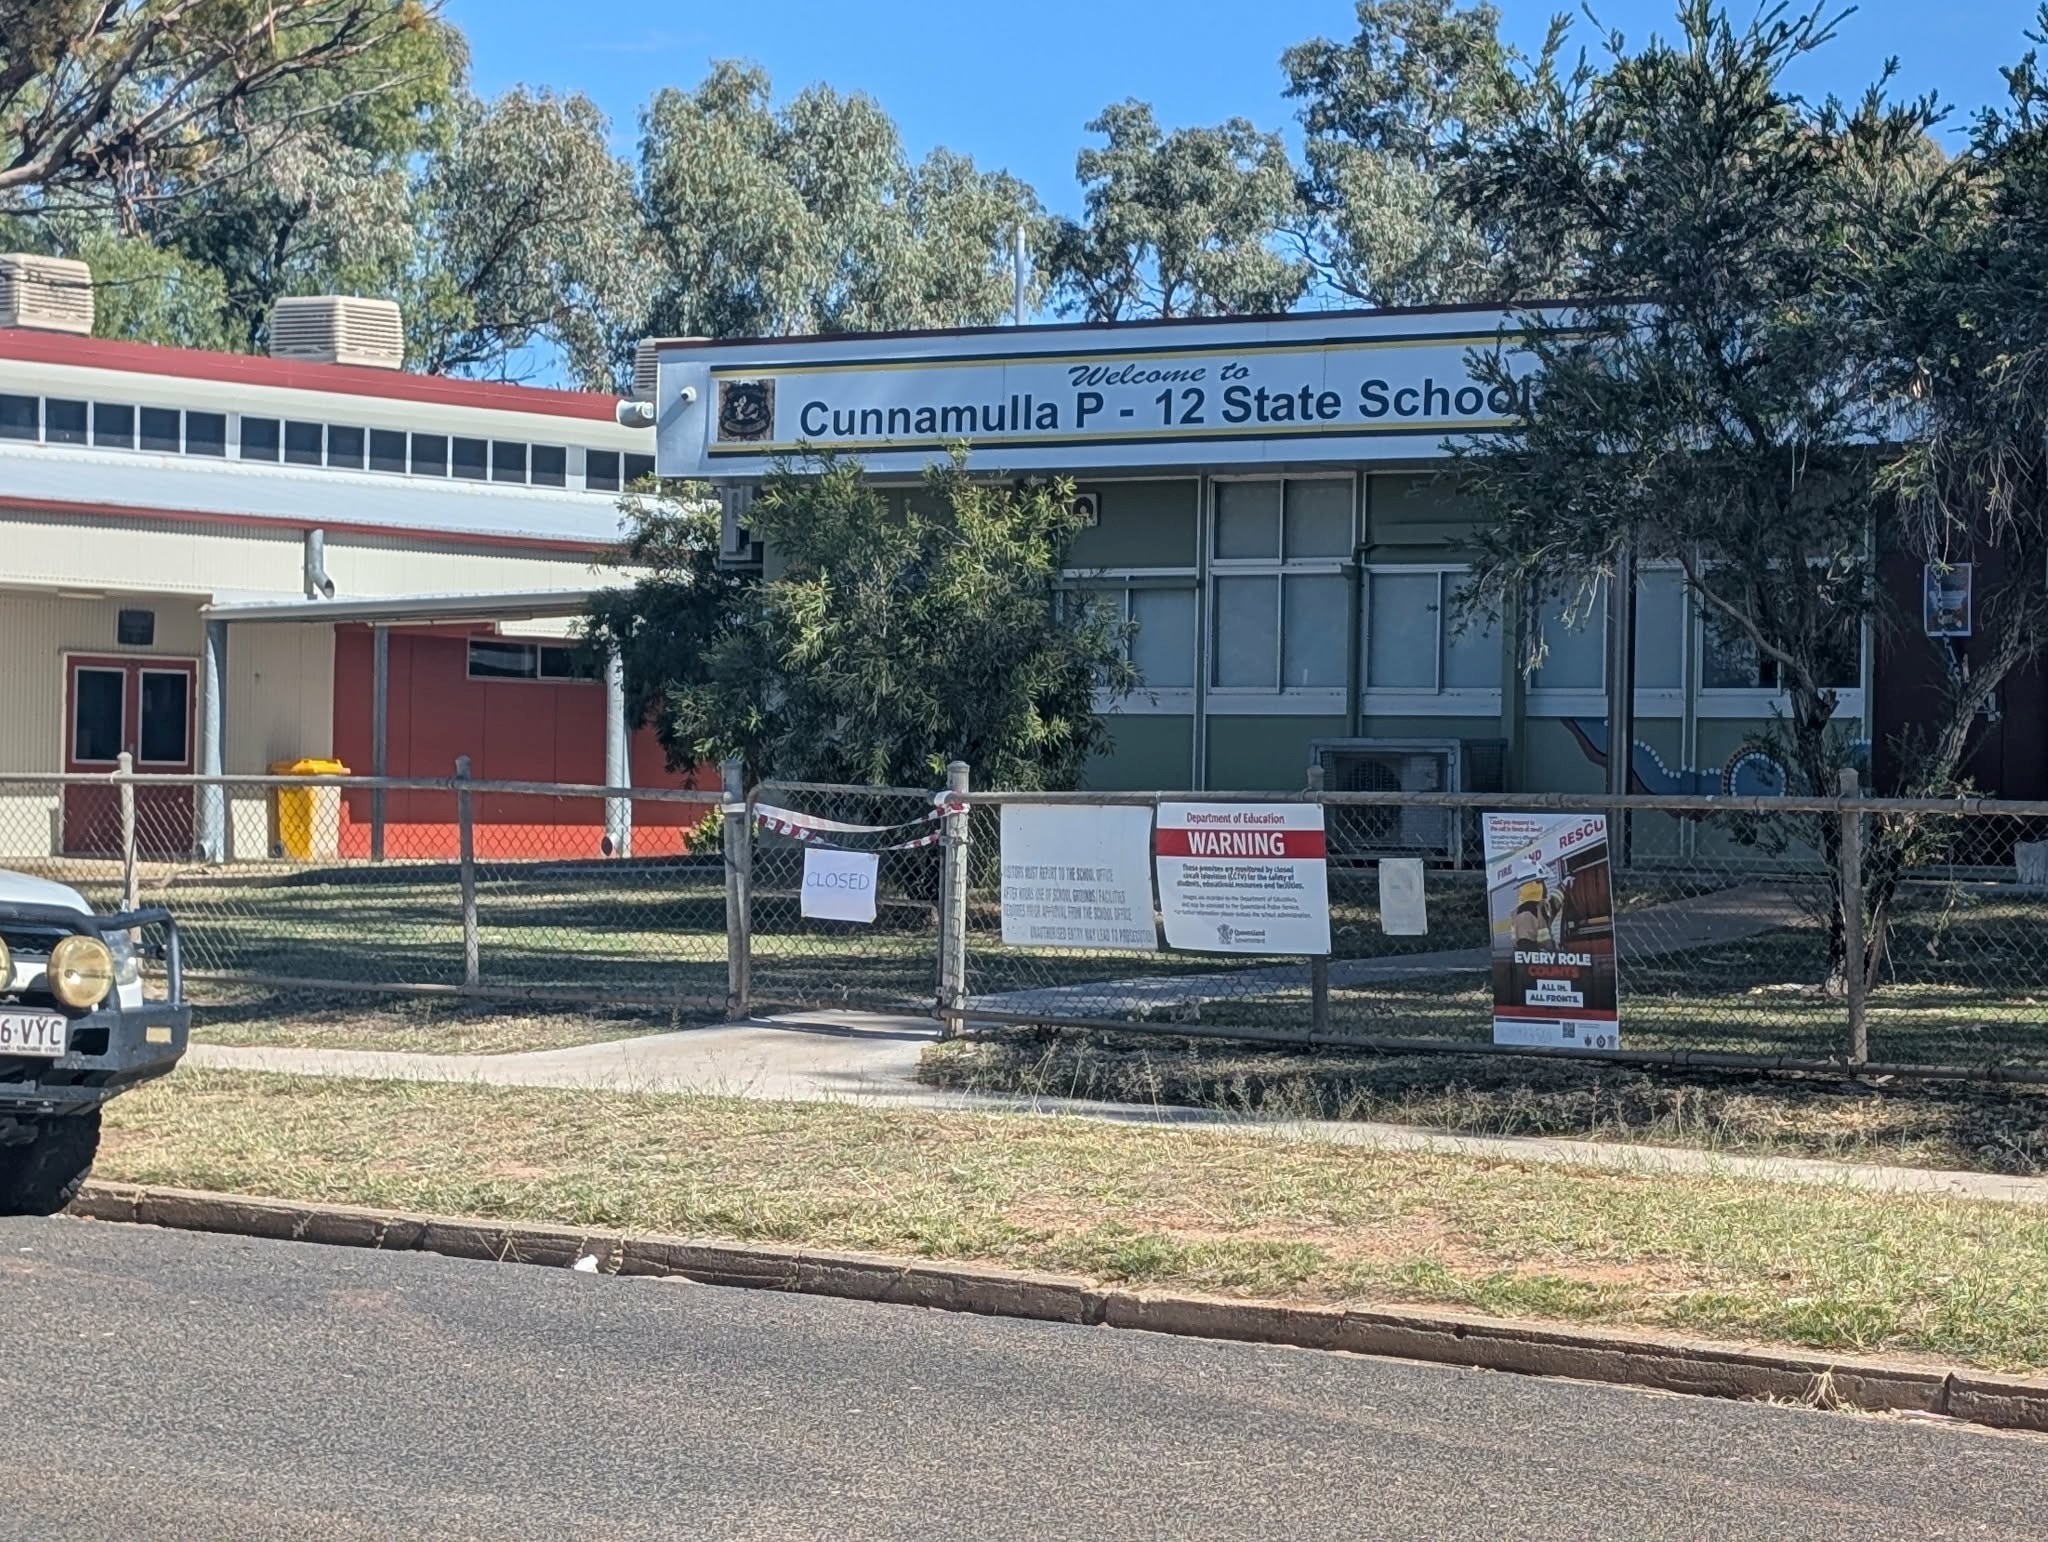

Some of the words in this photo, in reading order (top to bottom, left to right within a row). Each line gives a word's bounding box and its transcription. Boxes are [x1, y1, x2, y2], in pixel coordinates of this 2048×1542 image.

[1068, 364, 1206, 387] Welcome
[1220, 362, 1249, 381] to
[800, 394, 1058, 437] Cunnamulla
[1076, 391, 1104, 428] P
[1119, 408, 1134, 417] -
[1155, 387, 1205, 425] 12
[1222, 384, 1341, 423] State
[1186, 812, 1231, 824] Department
[1233, 812, 1241, 823] of
[1243, 813, 1285, 824] Education
[1187, 831, 1285, 856] WARNING
[1235, 865, 1264, 873] monitored
[1266, 866, 1273, 874] by
[1274, 865, 1294, 873] closed
[1497, 864, 1512, 881] FIRE
[1525, 849, 1542, 865] ND
[1003, 865, 1024, 879] ISITORS
[1066, 867, 1075, 881] THE
[1077, 867, 1095, 881] SCHOOL
[1228, 873, 1247, 881] (CCTV)
[806, 871, 870, 890] CLOSED
[1053, 888, 1071, 902] SCHOOL
[1094, 907, 1113, 920] SCHOOL
[1514, 951, 1555, 965] EVERY
[1558, 953, 1592, 966] ROLE
[1528, 966, 1580, 978] COUNTS
[1541, 983, 1556, 991] ALL
[1530, 994, 1546, 1002] ALL
